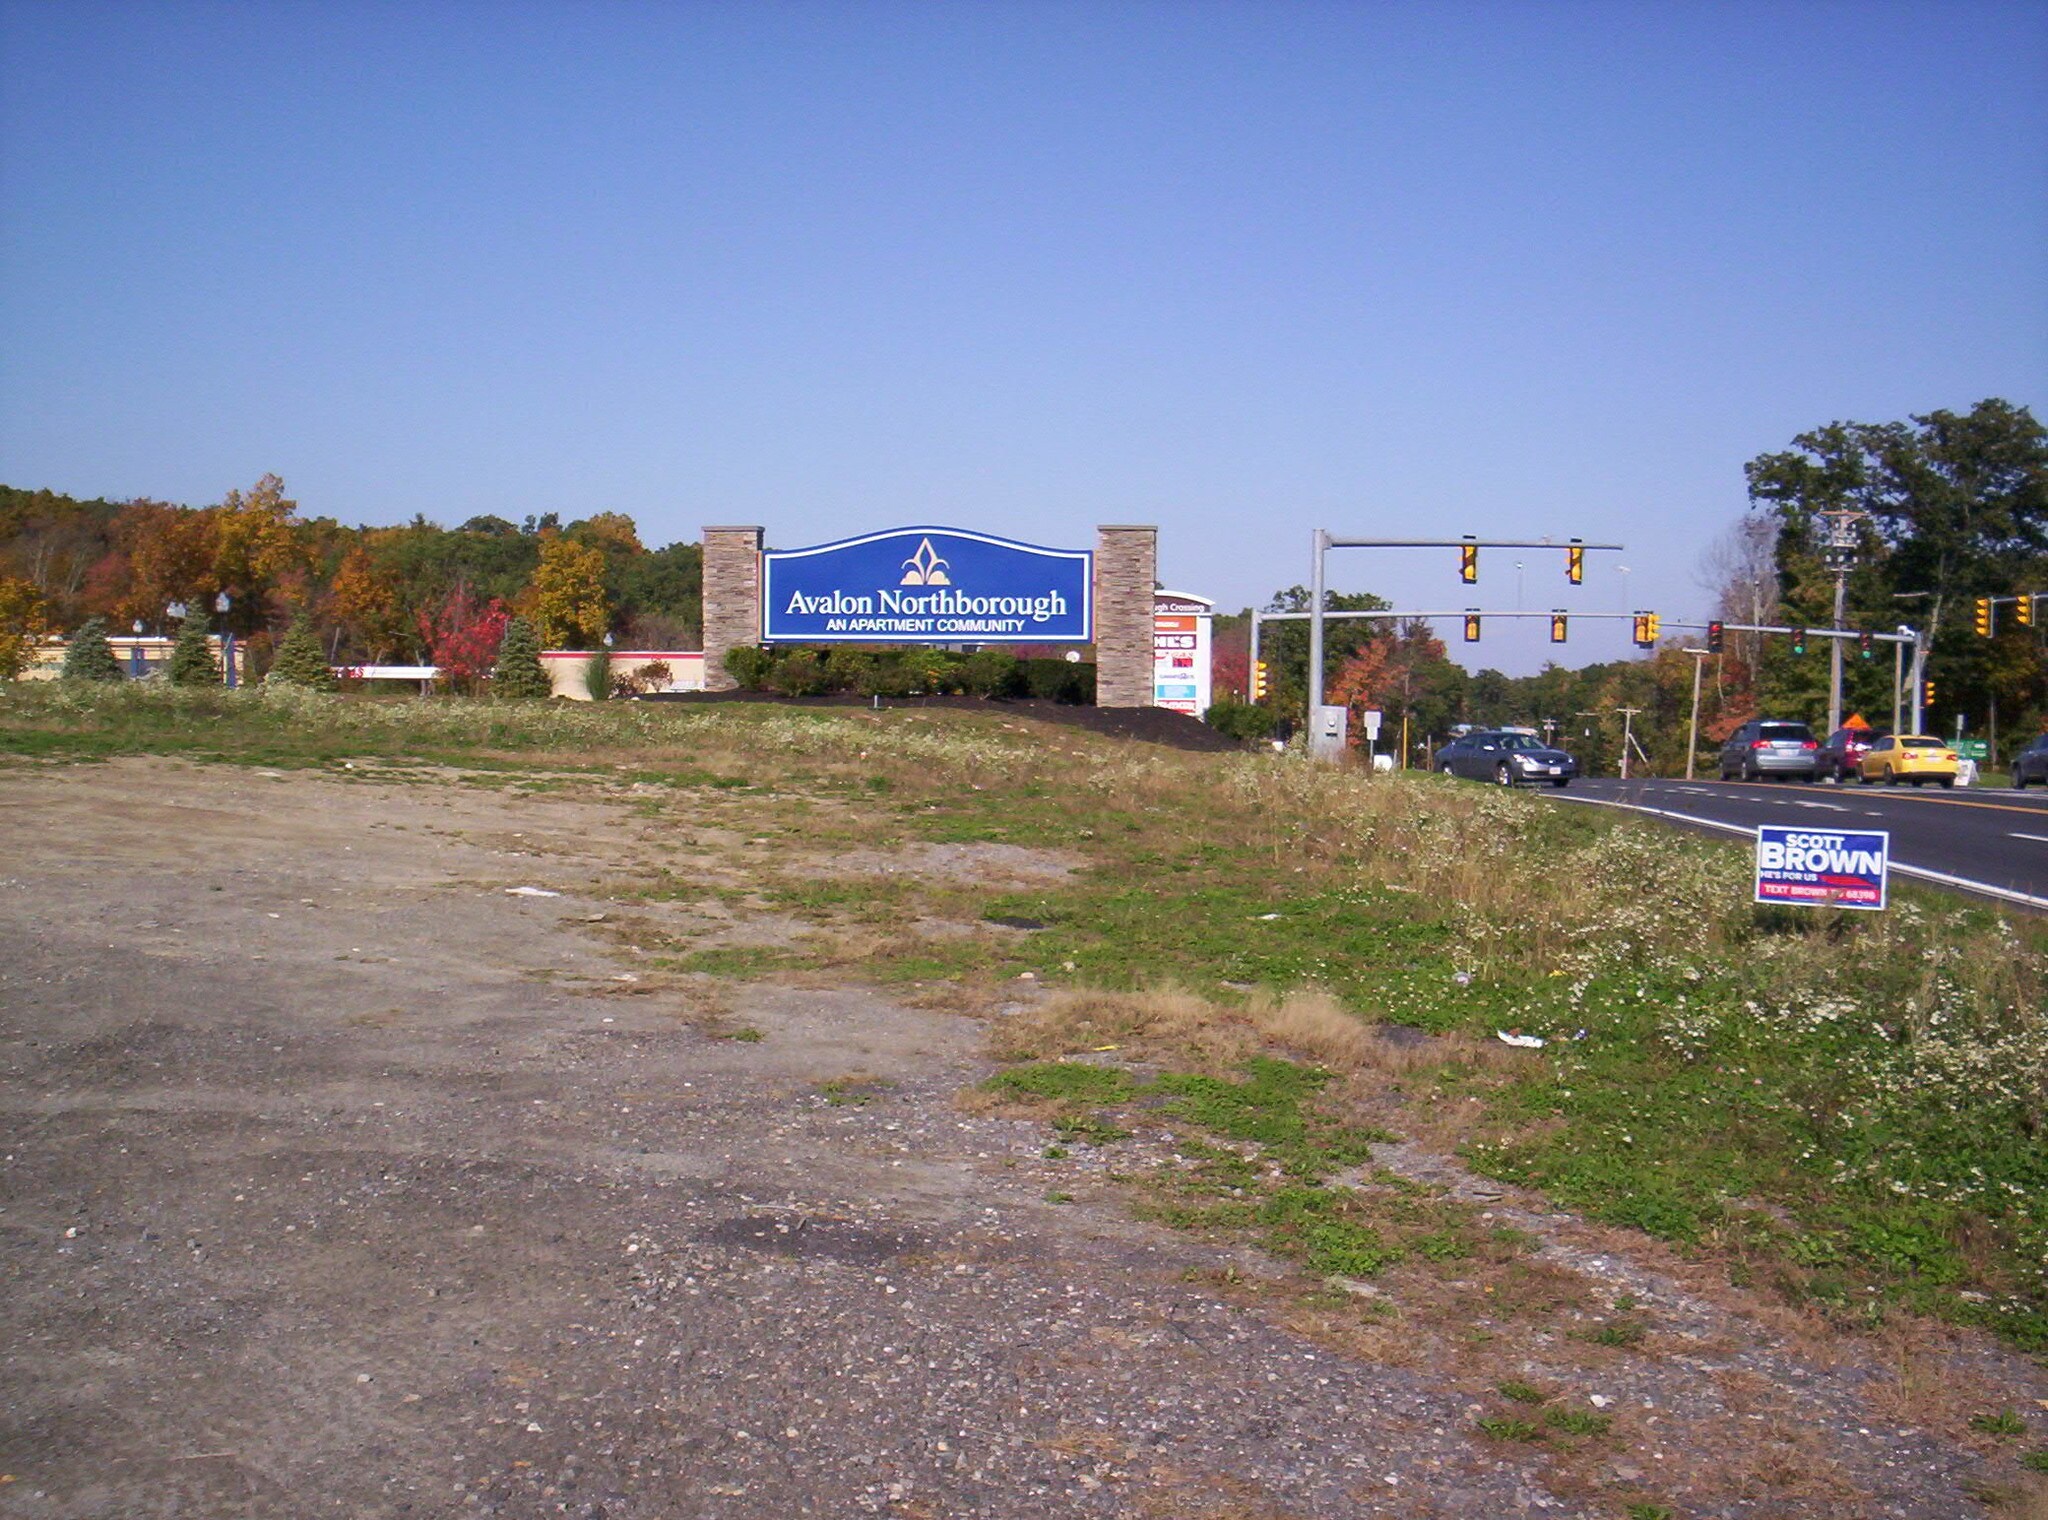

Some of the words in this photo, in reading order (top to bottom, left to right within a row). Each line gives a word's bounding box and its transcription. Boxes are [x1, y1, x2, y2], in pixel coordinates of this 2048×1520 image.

[785, 590, 872, 615] Avalon
[878, 589, 1067, 622] Northborough
[1170, 603, 1205, 612] Crossing
[826, 619, 848, 631] AN
[849, 619, 934, 632] APARTMENT
[937, 619, 1025, 632] COMMUNITY
[1786, 833, 1845, 850] SCOTT
[1761, 841, 1882, 875] BROWN
[1783, 872, 1802, 881] FOR
[1804, 873, 1818, 881] US
[1764, 885, 1789, 894] TEXT
[1791, 887, 1827, 896] BROWN
